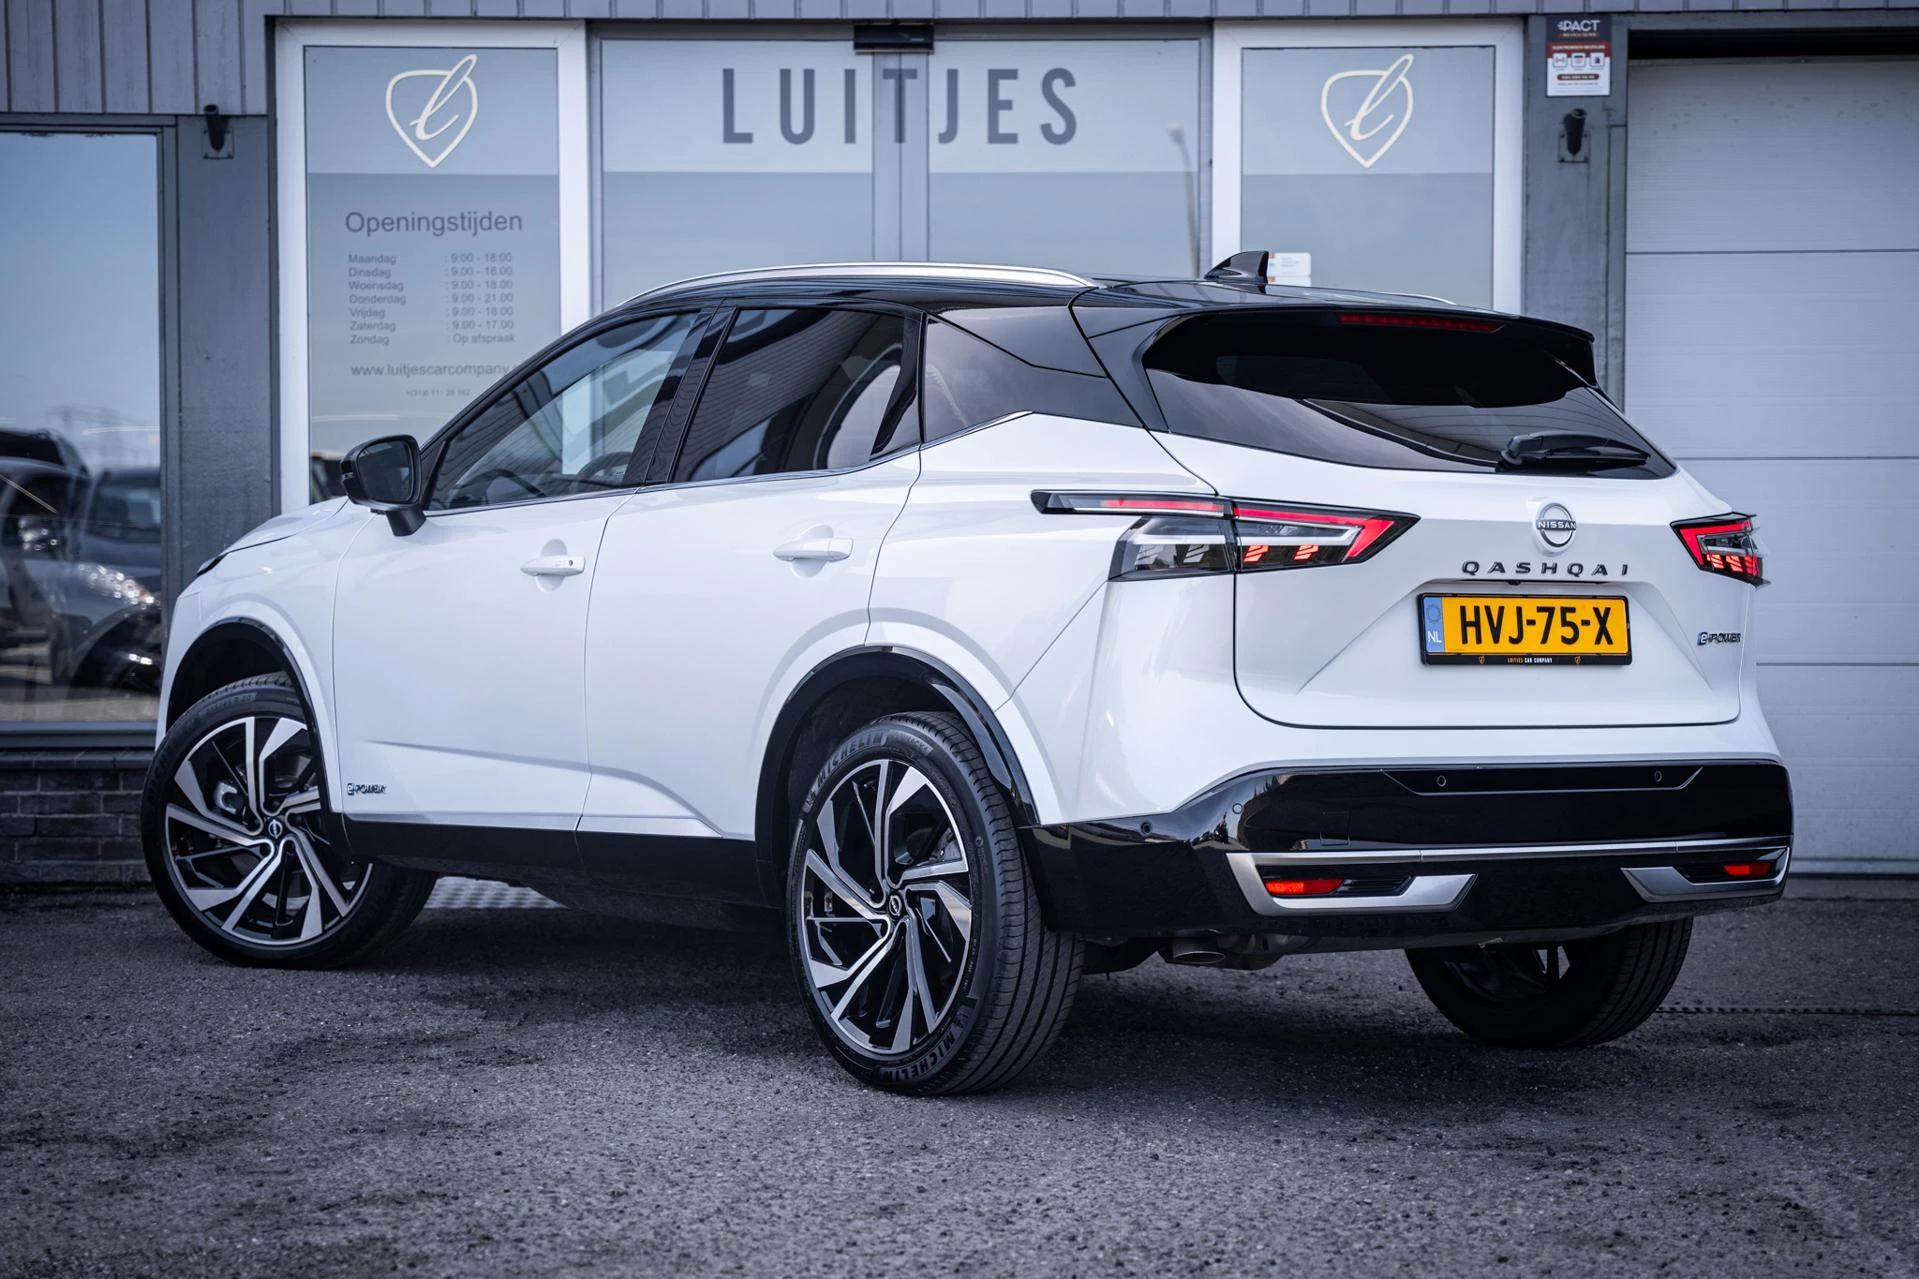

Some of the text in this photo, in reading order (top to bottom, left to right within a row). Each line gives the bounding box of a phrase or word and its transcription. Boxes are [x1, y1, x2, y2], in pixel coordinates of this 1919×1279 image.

[722, 67, 1077, 145] LUITJES
[345, 211, 522, 237] Openingstijden
[348, 254, 397, 265] Maandag
[348, 267, 391, 279] Dinsdag
[349, 281, 404, 292] Woensdag
[349, 294, 407, 306] Donderdag
[349, 308, 385, 319] Vrijdag
[350, 321, 396, 333] Zaterdag
[350, 334, 390, 346] Zondag
[452, 333, 469, 346] Op
[1538, 521, 1576, 529] NISSAN
[1462, 560, 1628, 577] QASHQAI
[1460, 605, 1614, 646] HVJ-75-X
[1428, 630, 1442, 643] NL
